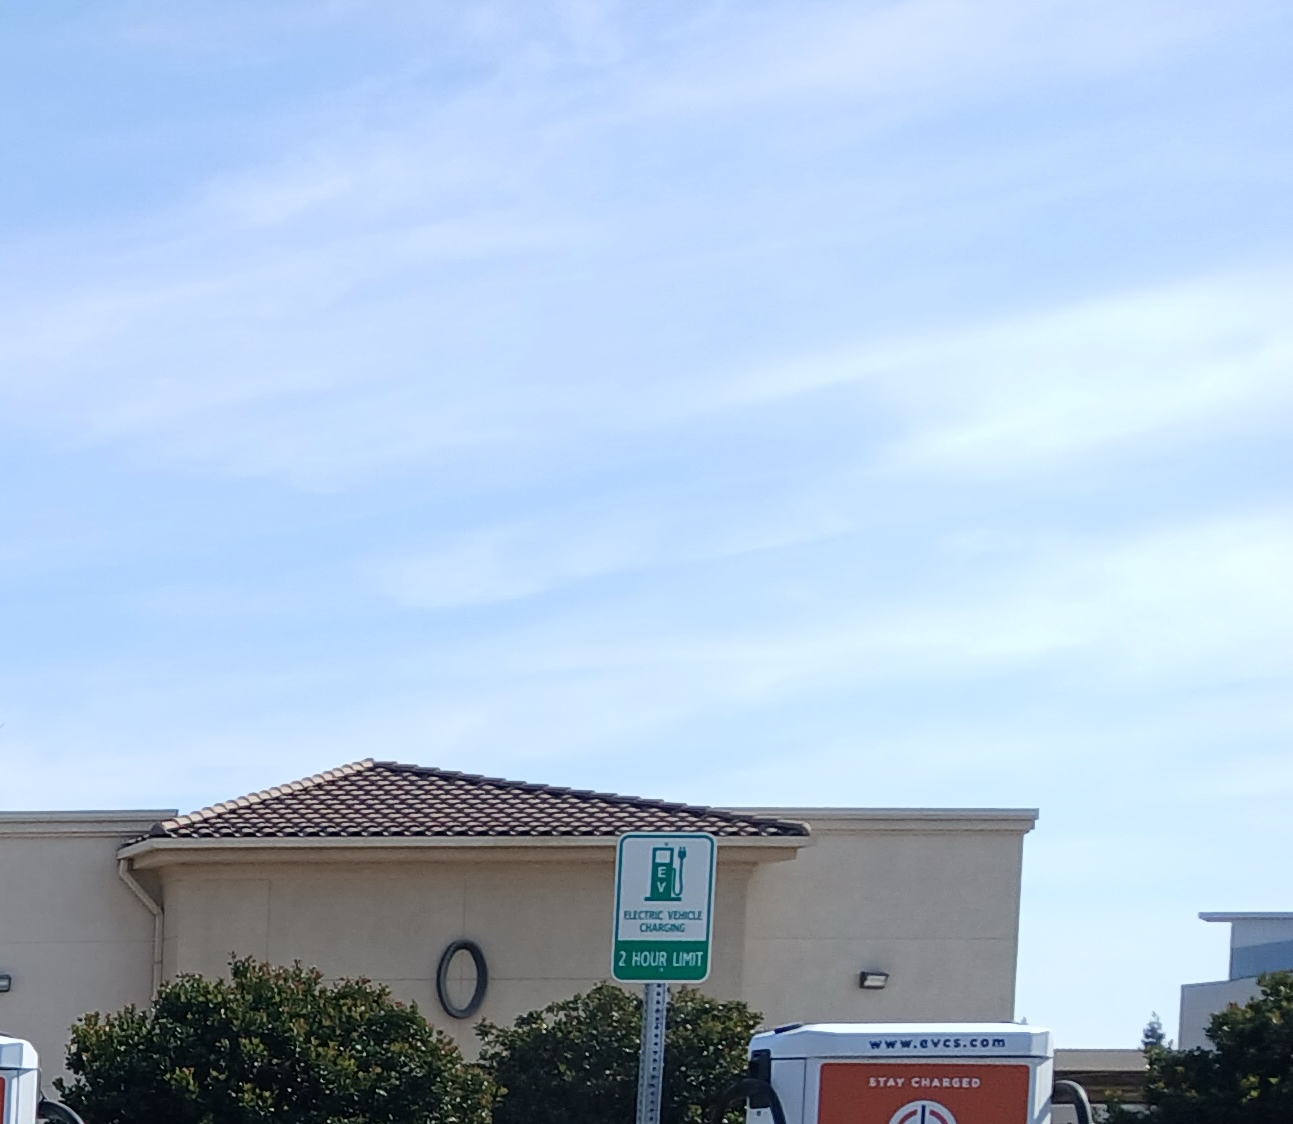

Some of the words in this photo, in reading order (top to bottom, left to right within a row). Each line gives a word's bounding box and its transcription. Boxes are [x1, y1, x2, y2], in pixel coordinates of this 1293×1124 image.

[624, 911, 663, 920] ELECTRIC
[668, 911, 703, 920] VEHICLE
[640, 923, 685, 932] CHARGING
[618, 951, 626, 966] 2
[632, 952, 667, 967] HOUR
[673, 951, 704, 966] LIMIT
[869, 1038, 1005, 1049] www.evcs.com
[868, 1077, 905, 1087] STAY
[911, 1077, 981, 1088] CHARGED
